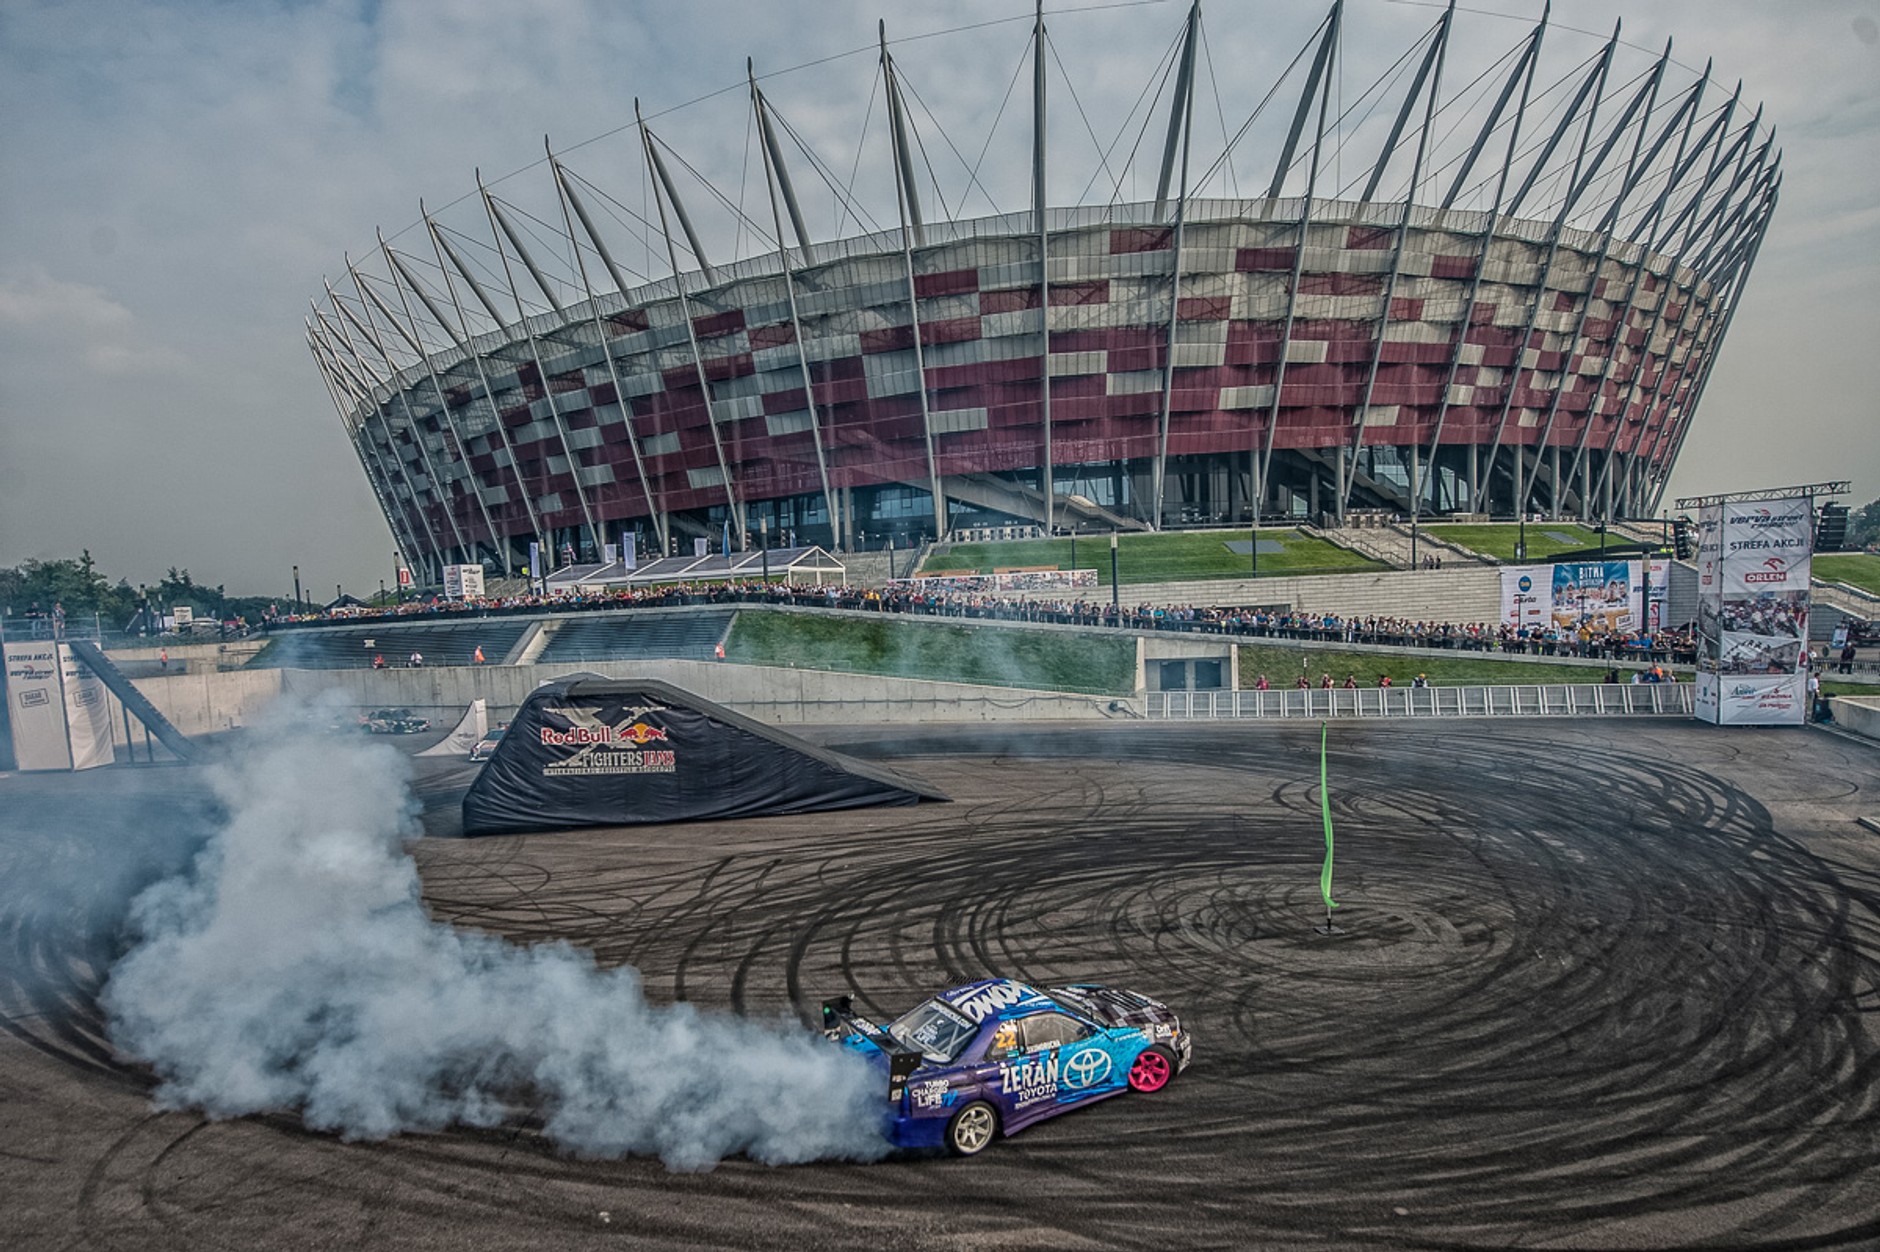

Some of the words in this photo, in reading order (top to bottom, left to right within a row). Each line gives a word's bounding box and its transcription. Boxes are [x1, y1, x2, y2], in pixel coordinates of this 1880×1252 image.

[1730, 540, 1770, 551] STREFA
[1773, 538, 1804, 549] AKCJI
[1746, 572, 1785, 582] ORLEN
[541, 727, 576, 745] Red
[577, 725, 611, 744] Bull
[583, 751, 643, 768] FIGHTERS
[995, 1031, 1017, 1049] 22
[1000, 1052, 1059, 1094] ŻERAŃ
[1018, 1083, 1058, 1102] TOYOTA
